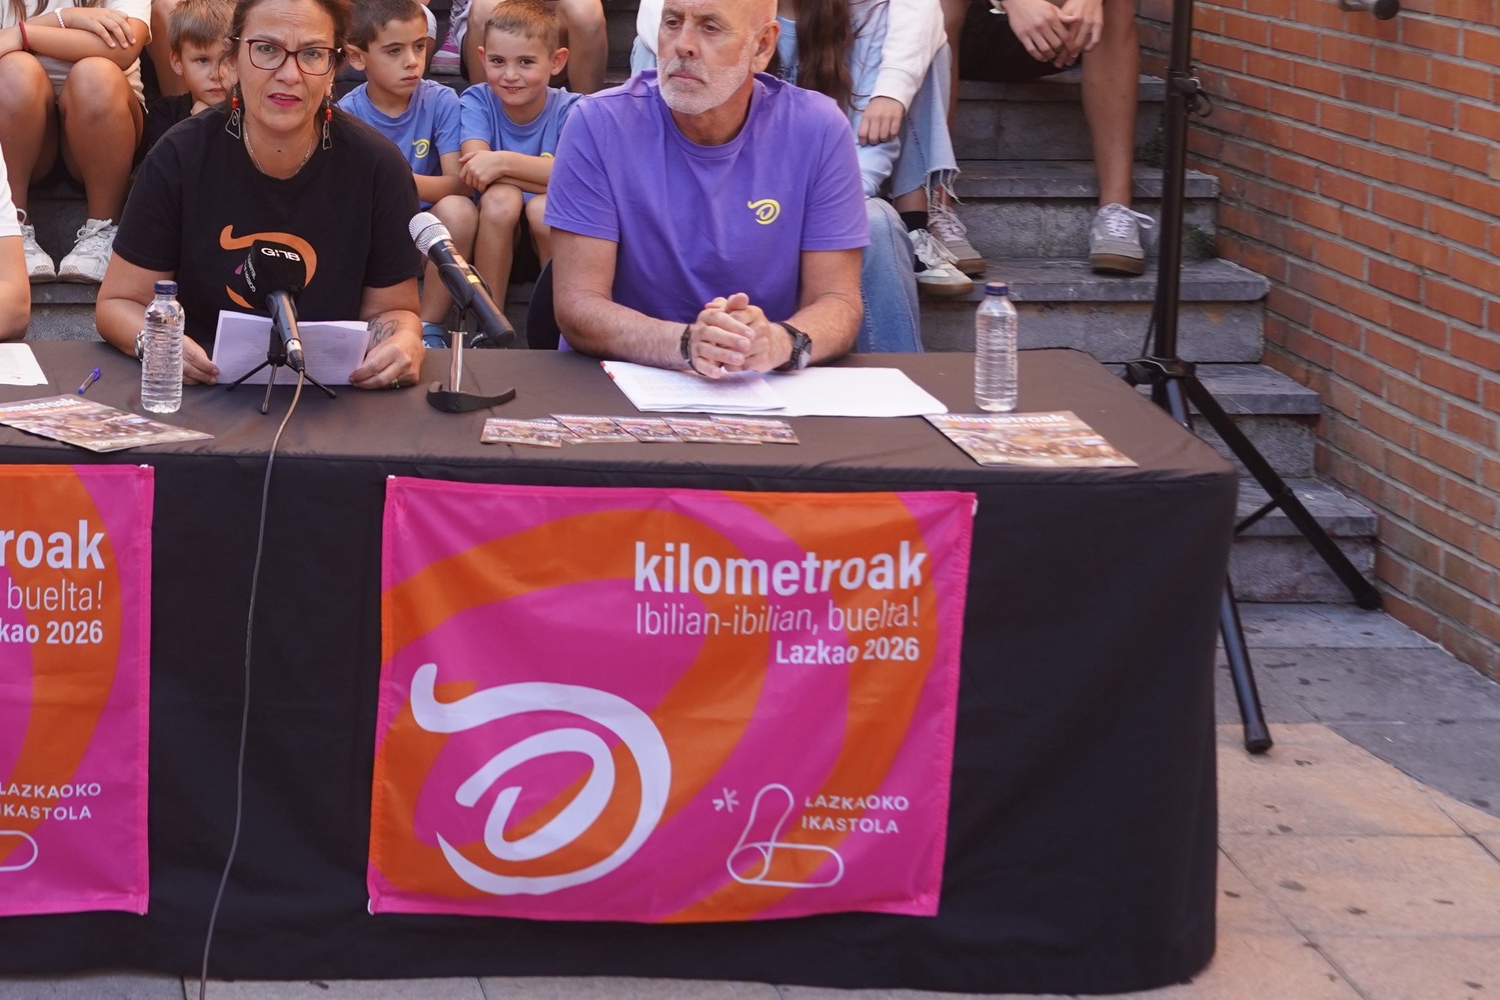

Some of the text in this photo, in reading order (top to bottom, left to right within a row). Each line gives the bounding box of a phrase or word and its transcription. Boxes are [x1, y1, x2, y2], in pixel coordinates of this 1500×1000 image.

[634, 540, 926, 595] kilometroak
[6, 576, 103, 611] buelta!
[46, 619, 103, 645] 2026
[636, 600, 920, 638] Ibilian-ibilian, buelta!
[776, 637, 920, 665] Lazkao 2026
[804, 794, 909, 812] LAZKAOKO
[801, 815, 899, 835] IKASTOLA
